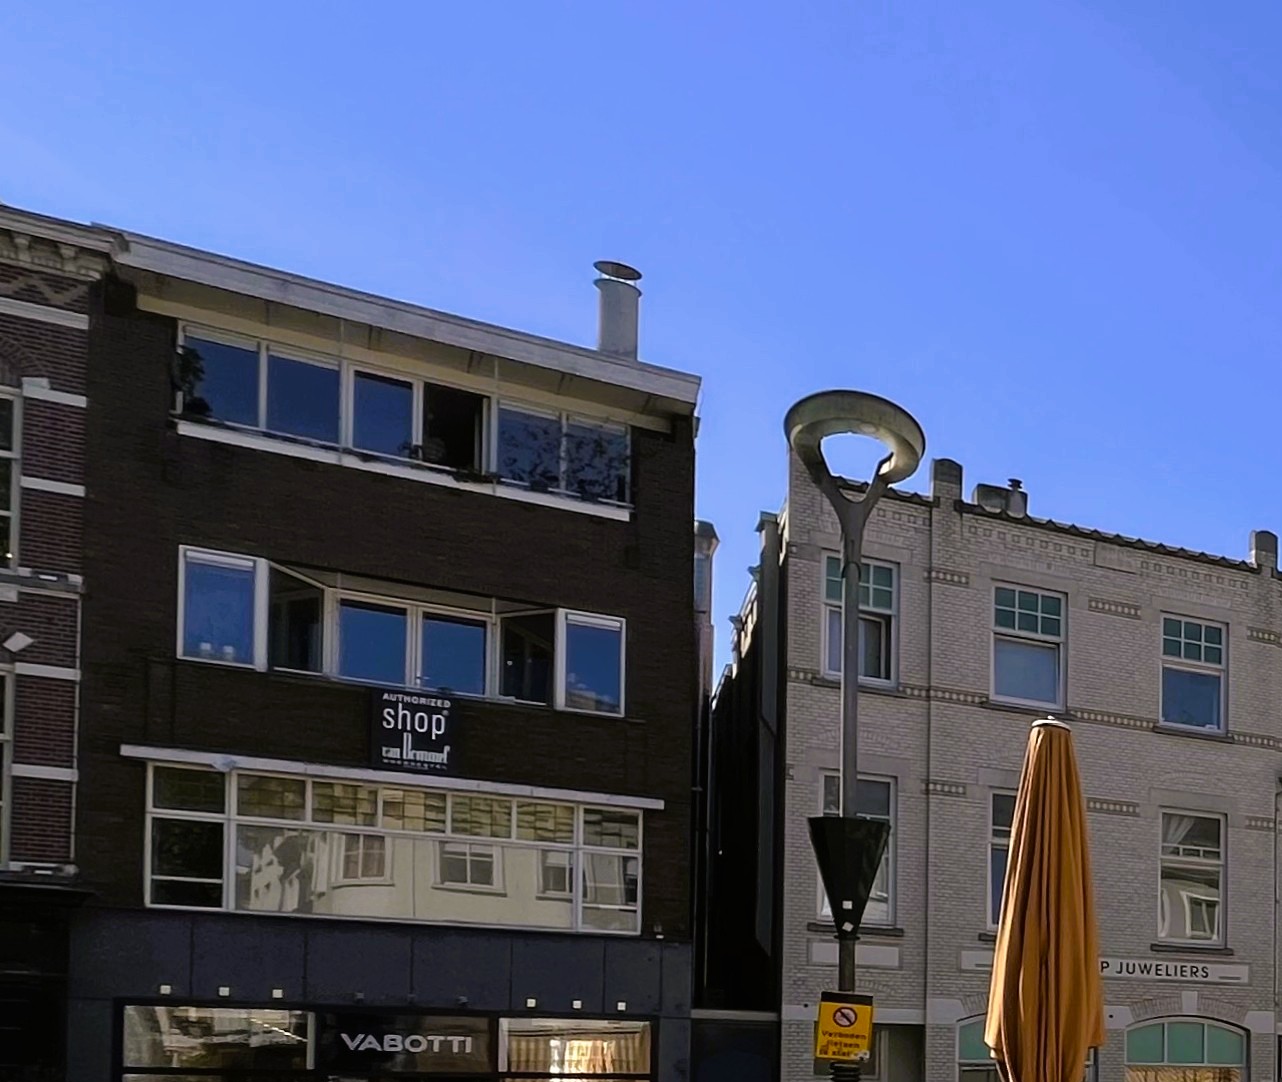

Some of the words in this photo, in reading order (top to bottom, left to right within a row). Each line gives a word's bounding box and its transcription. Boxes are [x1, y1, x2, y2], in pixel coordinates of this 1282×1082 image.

[382, 692, 452, 709] AUTHORIZED
[382, 702, 446, 740] shop
[1115, 961, 1209, 979] JUWELIERS
[340, 1033, 473, 1053] VABOTTI
